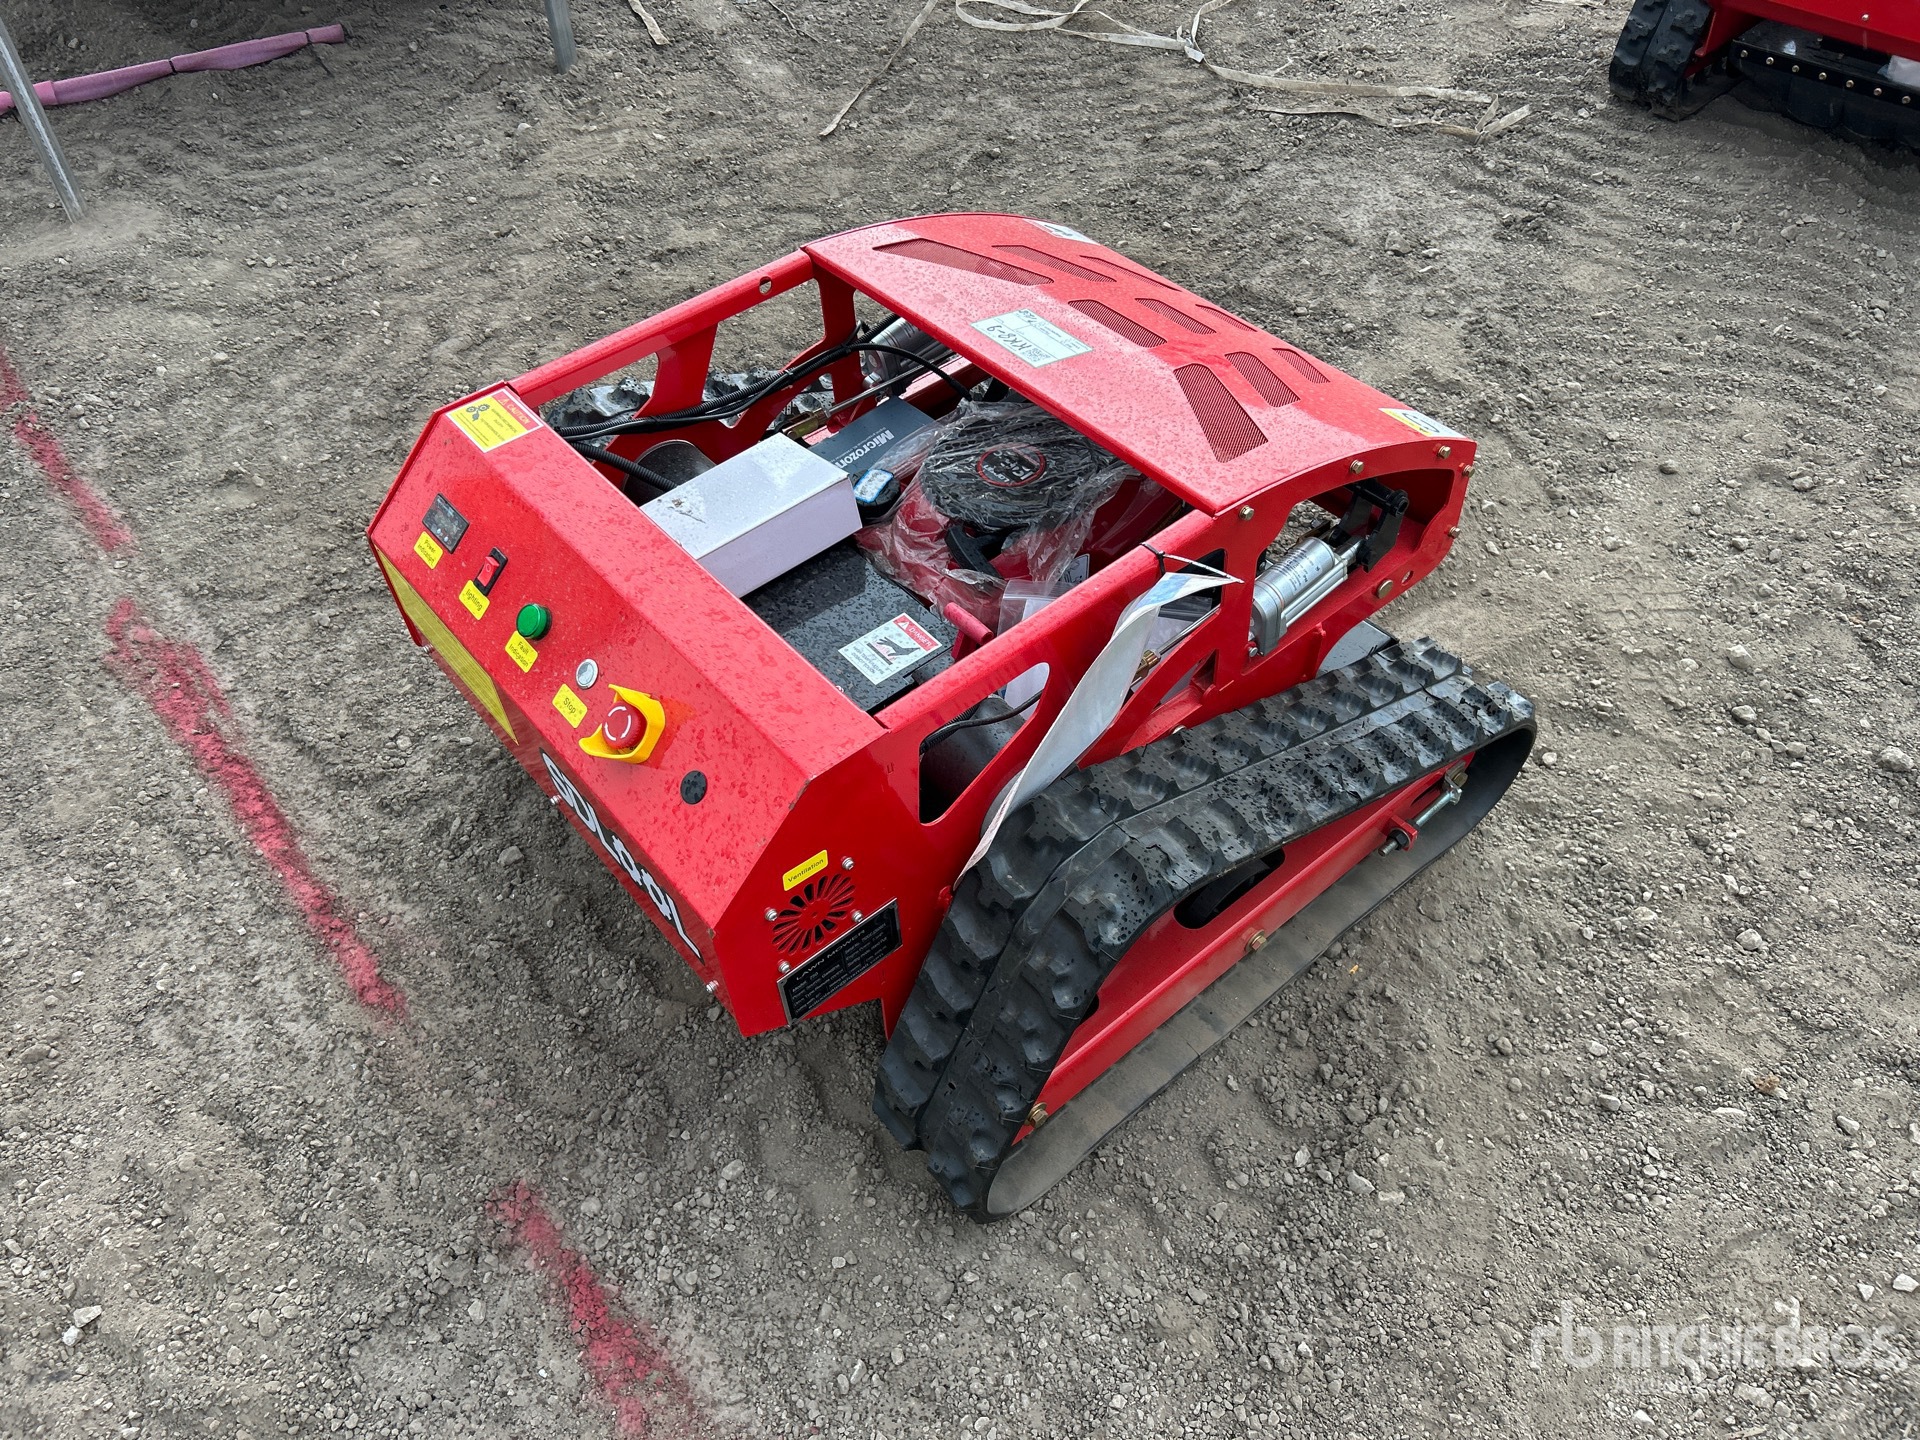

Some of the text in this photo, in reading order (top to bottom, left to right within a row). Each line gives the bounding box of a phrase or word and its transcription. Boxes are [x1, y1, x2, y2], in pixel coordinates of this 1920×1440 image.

[507, 403, 531, 424] CAUTION
[908, 627, 932, 647] DANGER
[517, 641, 530, 655] Fault
[563, 697, 577, 714] Stop
[787, 858, 824, 883] Ventilation
[796, 958, 825, 981] LAWN
[827, 930, 865, 959] MOWER
